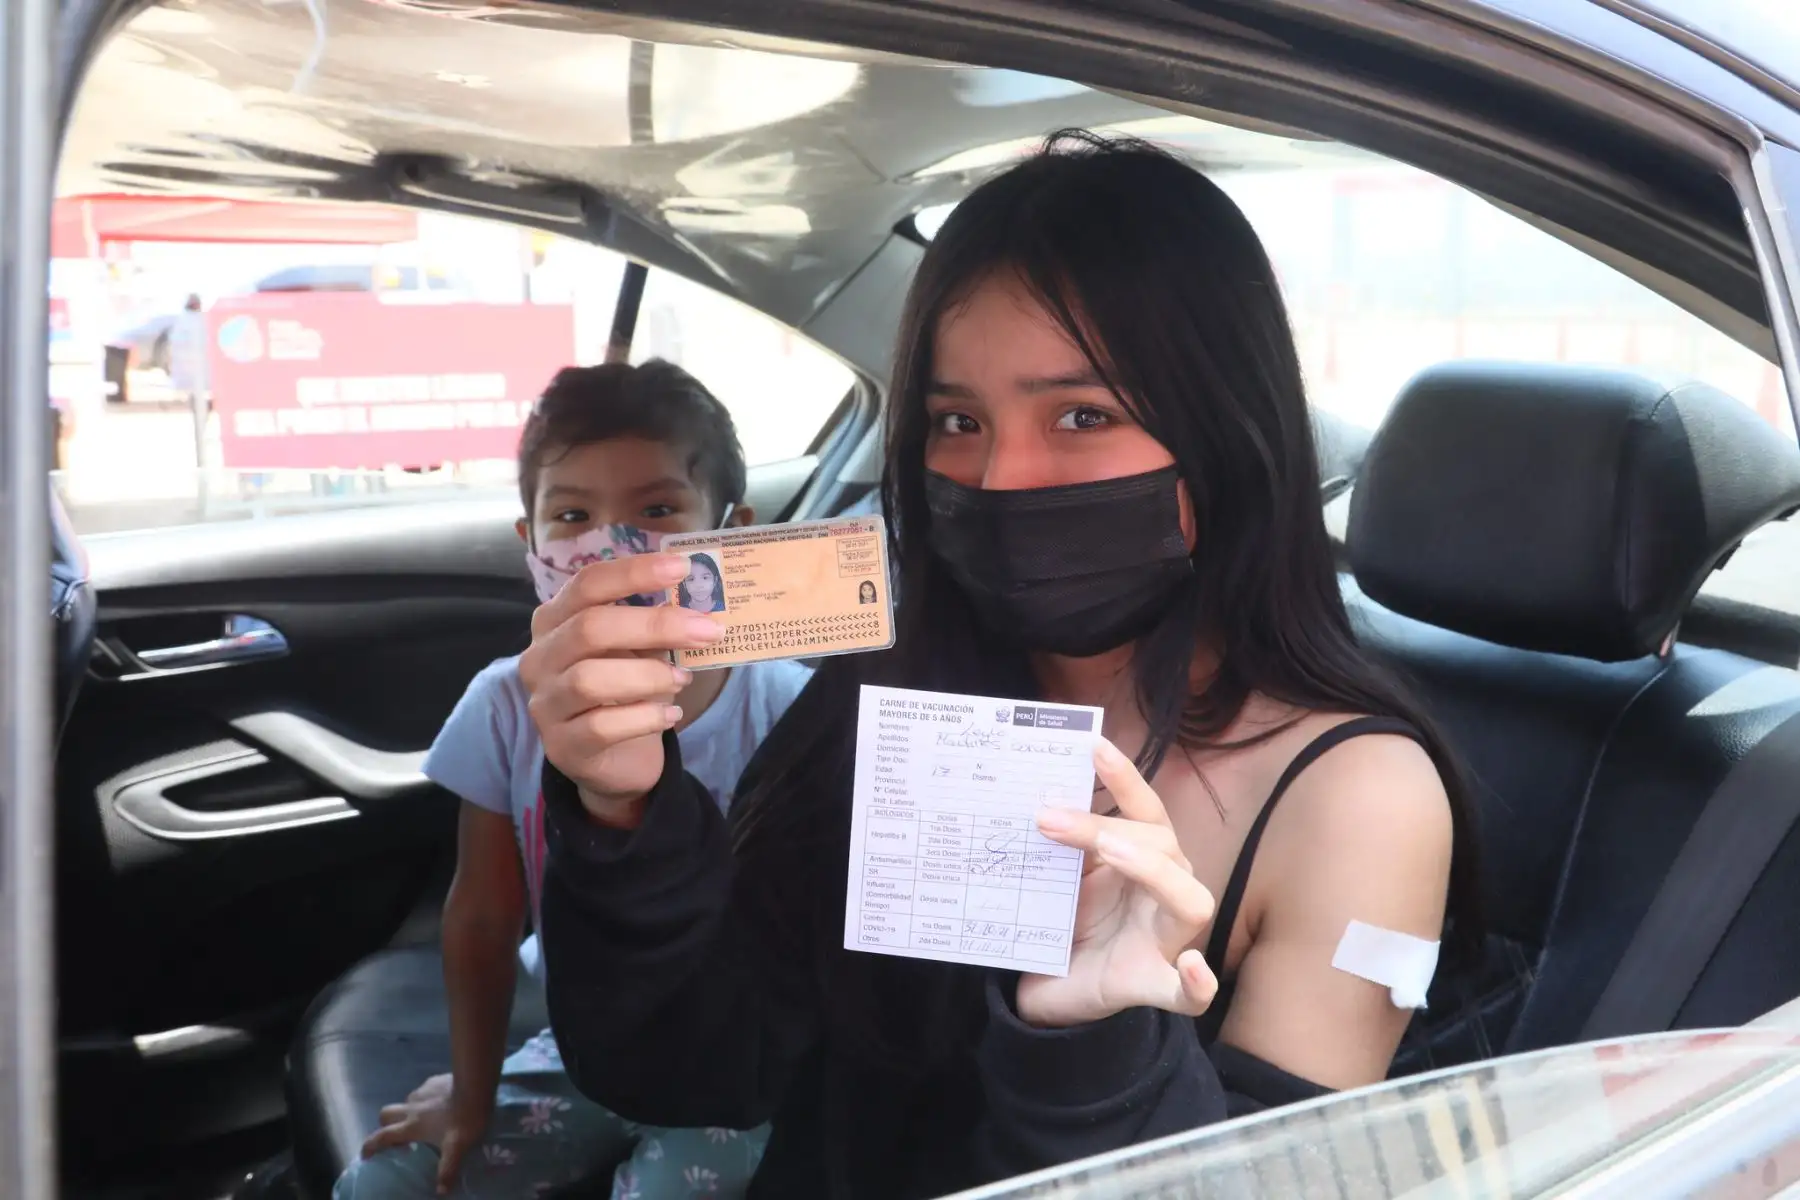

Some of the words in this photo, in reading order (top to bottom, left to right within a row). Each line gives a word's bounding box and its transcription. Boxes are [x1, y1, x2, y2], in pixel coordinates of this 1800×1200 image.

[879, 698, 907, 709] CARNE
[908, 699, 920, 709] DE
[921, 701, 975, 715] VACUNACIÓN
[879, 709, 918, 721] MAYORES
[919, 711, 931, 721] DE
[932, 713, 938, 722] 5
[939, 713, 962, 724] AÑOS
[1015, 711, 1034, 722] PERÚ
[863, 924, 896, 934] COVID-19
